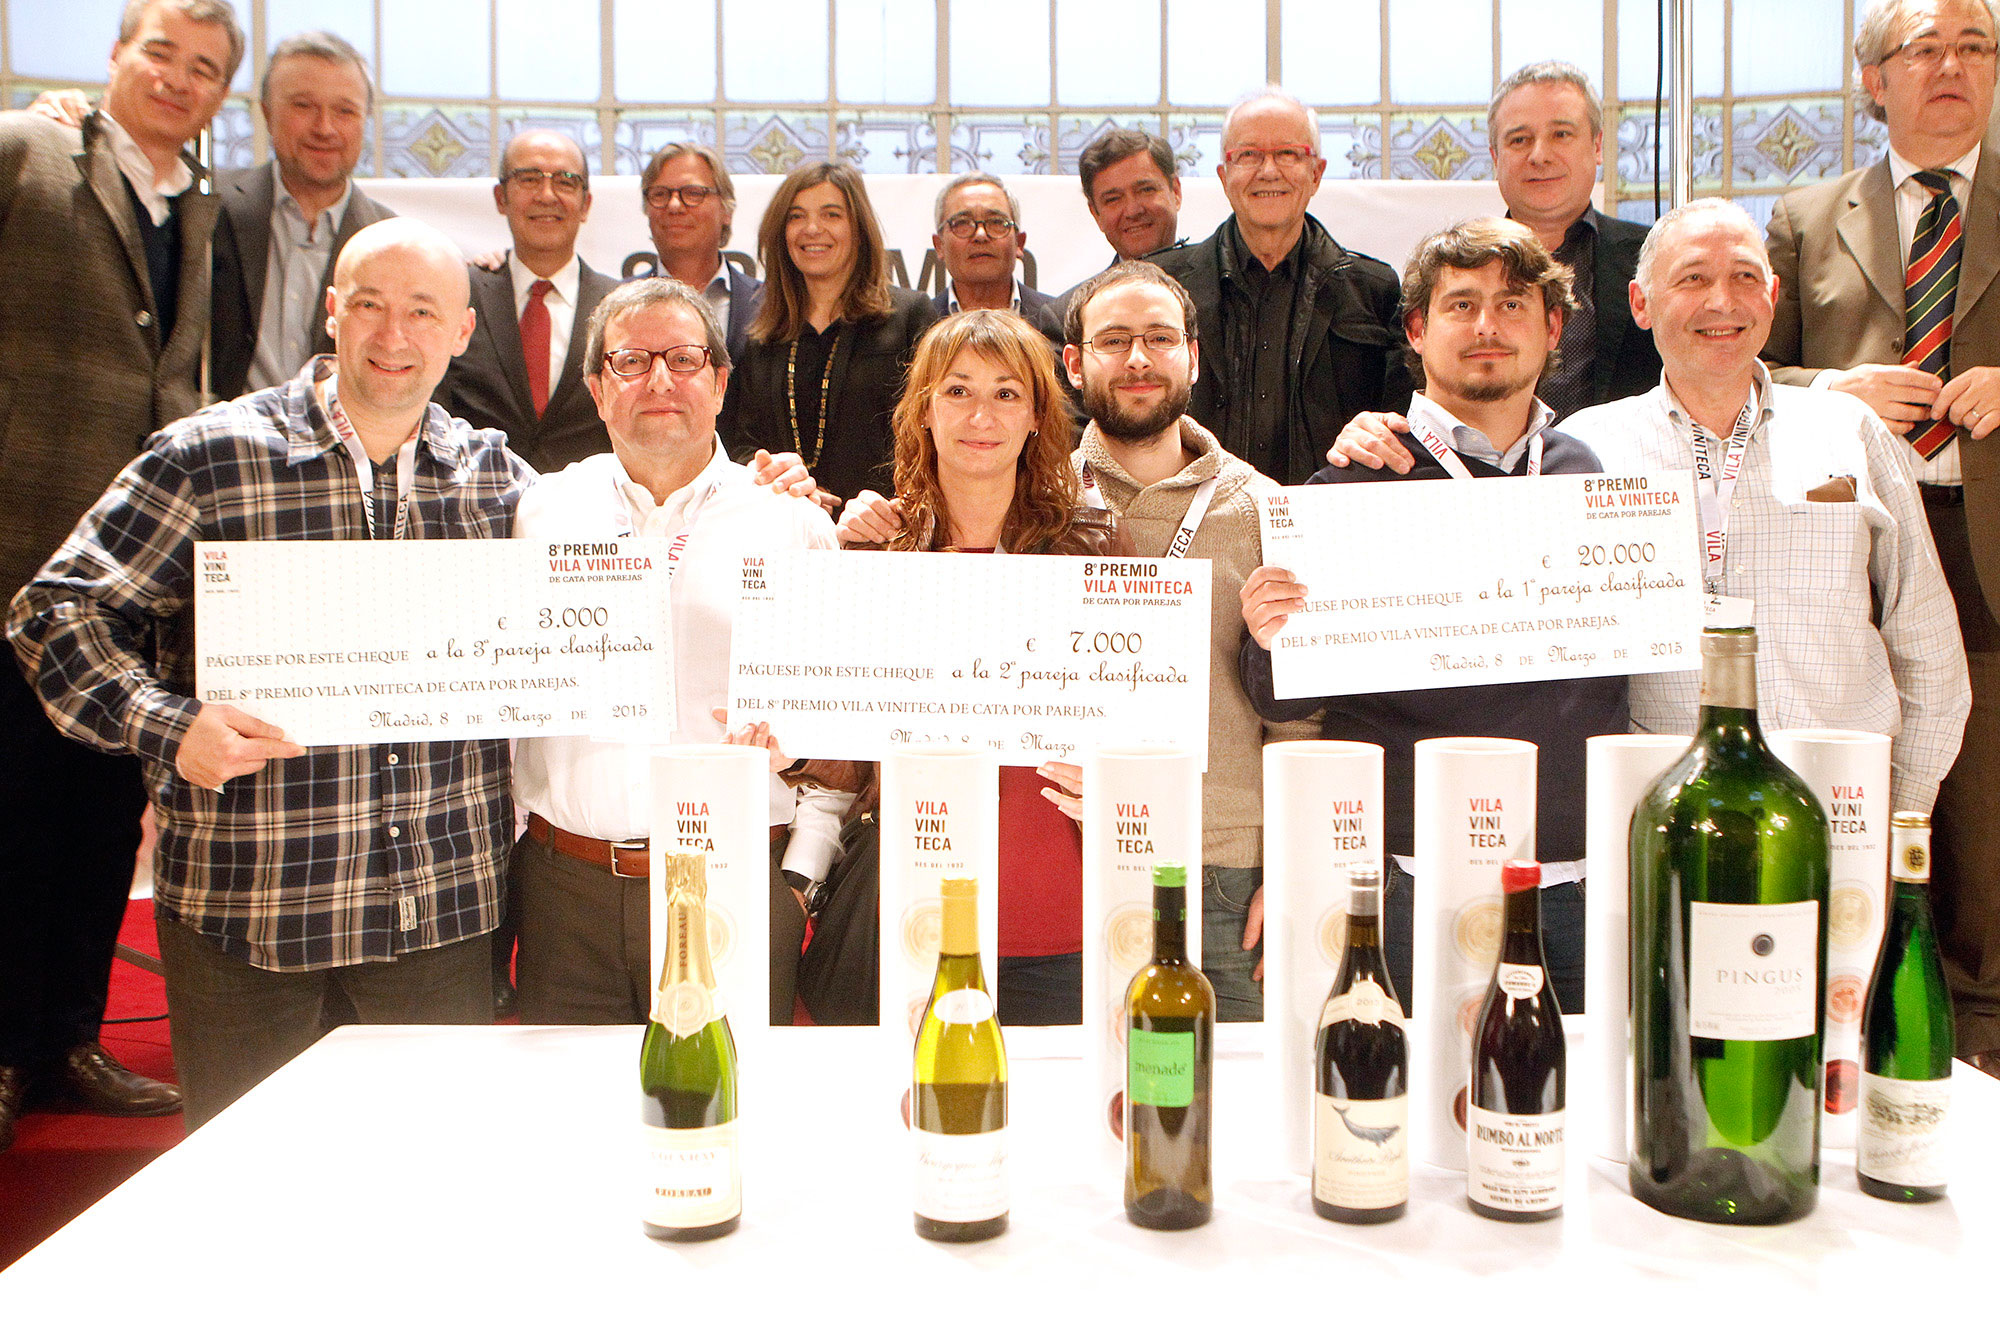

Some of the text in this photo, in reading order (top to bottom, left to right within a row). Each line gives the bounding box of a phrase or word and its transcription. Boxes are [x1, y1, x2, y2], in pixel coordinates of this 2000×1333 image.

[332, 411, 353, 440] VILA
[1423, 431, 1448, 459] VILA
[1691, 423, 1711, 480] VINITECA
[1722, 453, 1742, 480] VILA
[1598, 477, 1648, 491] PREMIO
[1268, 496, 1289, 505] VILA
[1585, 491, 1680, 509] VILA VINITECA
[1269, 507, 1289, 517] VINI
[1621, 510, 1637, 518] POR
[1638, 509, 1672, 517] PAREJAS
[1270, 519, 1294, 528] TECA
[564, 542, 618, 556] PREMIO
[668, 534, 689, 561] VILA
[1169, 527, 1194, 558] TECA
[1707, 531, 1722, 562] VILA
[204, 551, 228, 560] VILA
[743, 557, 764, 566] VILA
[1542, 542, 1656, 569] € 20.000
[204, 562, 226, 571] VINI
[549, 557, 653, 572] VILA VINITECA
[1100, 563, 1158, 577] PREMIO
[204, 573, 231, 582] TECA
[562, 575, 585, 583] CATA
[605, 574, 643, 582] PAREJAS
[742, 568, 762, 578] VINI
[742, 579, 766, 589] TECA
[1084, 579, 1193, 594] VILA VINITECA
[1296, 601, 1338, 613] UESE
[1341, 598, 1369, 610] POR
[1372, 596, 1404, 608] ESTE
[1406, 592, 1463, 606] CHEQUE
[1478, 591, 1490, 600] a
[1497, 578, 1514, 599] la
[1539, 581, 1593, 605] pareja
[1600, 569, 1686, 599] clasificada
[1083, 597, 1094, 605] DE
[1123, 598, 1140, 606] POR
[497, 606, 609, 630] € 3.000
[1281, 636, 1307, 648] DEL
[1325, 631, 1378, 645] PREMIO
[1380, 629, 1412, 641] VILA
[1414, 625, 1478, 639] VINITECA
[1481, 624, 1498, 635] DE
[1501, 621, 1535, 633] CATA
[1538, 619, 1563, 630] POR
[1566, 615, 1620, 631] PAREJAS.
[1026, 630, 1143, 653] € 7.000
[206, 652, 272, 667] PÁGUESE
[275, 653, 310, 665] POR
[309, 652, 344, 664] ESTE
[347, 650, 409, 664] CHEQUE
[426, 649, 438, 659] a
[447, 637, 465, 659] la
[491, 642, 552, 666] pareja
[559, 633, 654, 662] clasificada
[1430, 641, 1682, 671] Madrid, 8 DE Marzo DE 2015
[738, 662, 800, 676] PÁGUESE
[804, 665, 833, 676] POR
[836, 666, 870, 677] ESTE
[873, 667, 934, 681] CHEQUE
[952, 668, 963, 678] a
[972, 658, 991, 679] la
[1018, 665, 1080, 690] pareja
[1089, 661, 1189, 691] clasificada
[206, 689, 236, 701] DEL
[256, 686, 313, 699] PREMIO
[316, 685, 351, 697] VILA
[353, 682, 423, 695] VINITECA
[426, 682, 446, 693] DE
[449, 681, 486, 692] CATA
[489, 679, 518, 690] POR
[521, 677, 580, 691] PAREJAS.
[368, 704, 648, 727] Madrid, 8 DE Marzo DE 2015
[737, 698, 764, 709] DEL
[782, 699, 838, 711] PREMIO
[841, 700, 874, 712] VILA
[877, 701, 946, 714] VINITECA
[949, 703, 969, 714] DE
[972, 704, 1009, 715] CATA
[1013, 704, 1042, 715] POR
[1046, 705, 1107, 720] PAREJAS.
[1020, 731, 1076, 758] Marzo
[1832, 786, 1864, 799] VILA
[677, 802, 709, 816] VILA
[916, 800, 948, 815] VILA
[1116, 803, 1150, 817] VILA
[1333, 800, 1364, 814] VILA
[1469, 799, 1504, 812] VILA
[1832, 803, 1862, 816] VINI
[677, 820, 707, 834] VINI
[915, 818, 945, 833] VINI
[1116, 821, 1147, 835] VINI
[1333, 818, 1362, 832] VINI
[1469, 816, 1501, 829] VINI
[1831, 820, 1867, 833] TECA
[914, 836, 952, 851] TECA
[1117, 839, 1154, 853] TECA
[1333, 836, 1367, 850] TECA
[1469, 834, 1507, 847] TECA
[678, 911, 687, 968] FOREAU
[1717, 968, 1802, 985] PINGUS
[1517, 1132, 1532, 1147] AL
